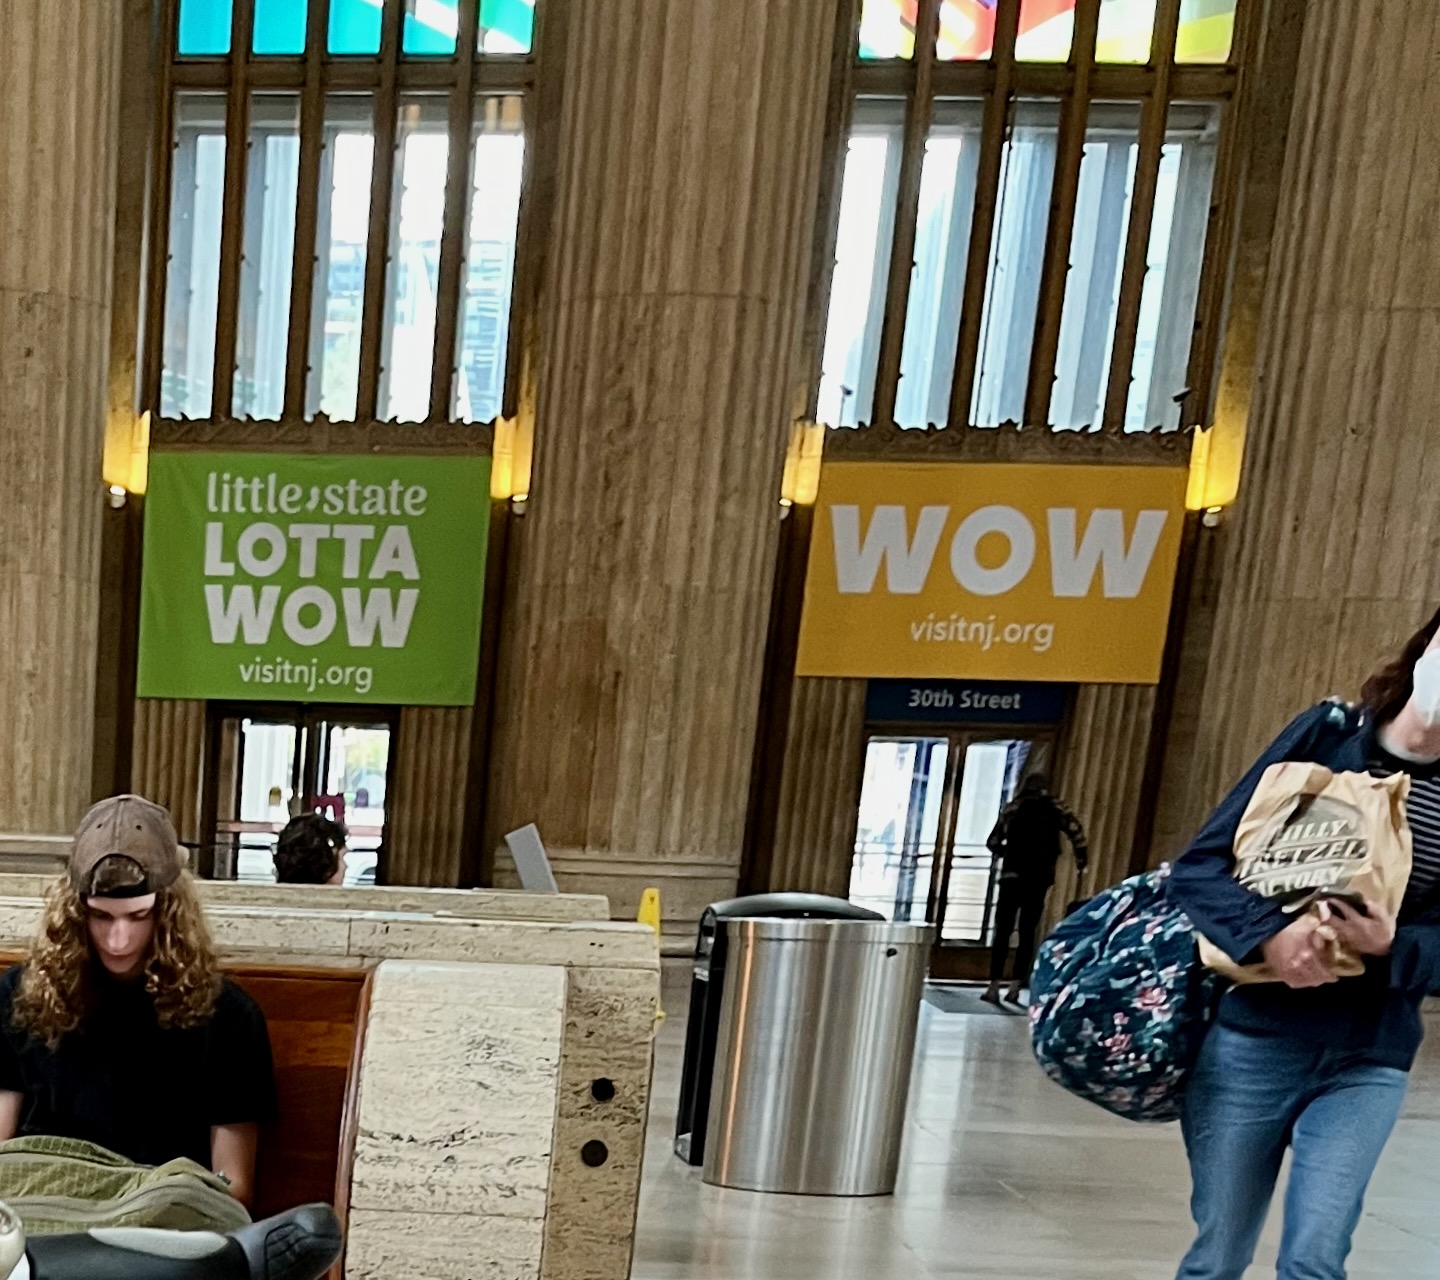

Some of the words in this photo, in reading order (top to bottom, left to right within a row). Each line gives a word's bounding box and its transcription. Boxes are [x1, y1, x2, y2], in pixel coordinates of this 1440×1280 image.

[206, 471, 303, 514] little
[322, 478, 428, 517] state
[204, 521, 421, 580] LOTTA
[829, 503, 1169, 599] WOW
[204, 583, 421, 649] WOW
[910, 611, 1055, 653] visitnj.org
[238, 655, 374, 694] visitnj.org
[907, 688, 954, 710] 30th
[959, 689, 1022, 711] Street
